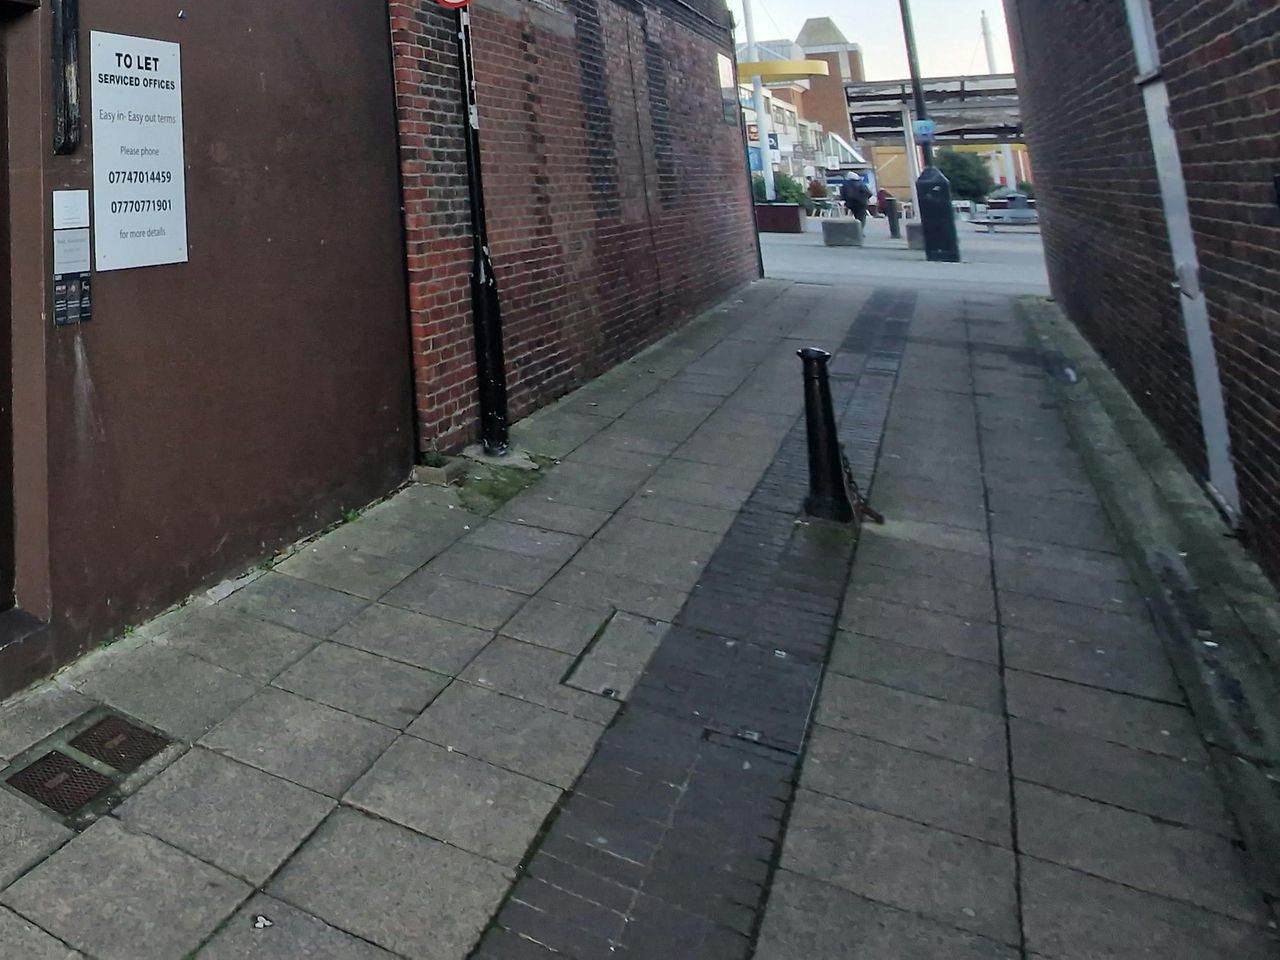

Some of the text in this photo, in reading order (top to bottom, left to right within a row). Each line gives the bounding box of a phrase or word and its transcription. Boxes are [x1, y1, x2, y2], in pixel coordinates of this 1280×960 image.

[115, 52, 160, 72] TO LET
[98, 73, 176, 91] SERVICED OFFICES
[99, 109, 116, 123] Easy
[128, 111, 143, 125] Easy
[145, 113, 157, 123] out
[158, 114, 177, 125] terms
[120, 145, 160, 158] Please phone
[108, 171, 172, 184] 07747014459
[111, 199, 172, 213] 07770771901
[120, 227, 166, 239] for more details
